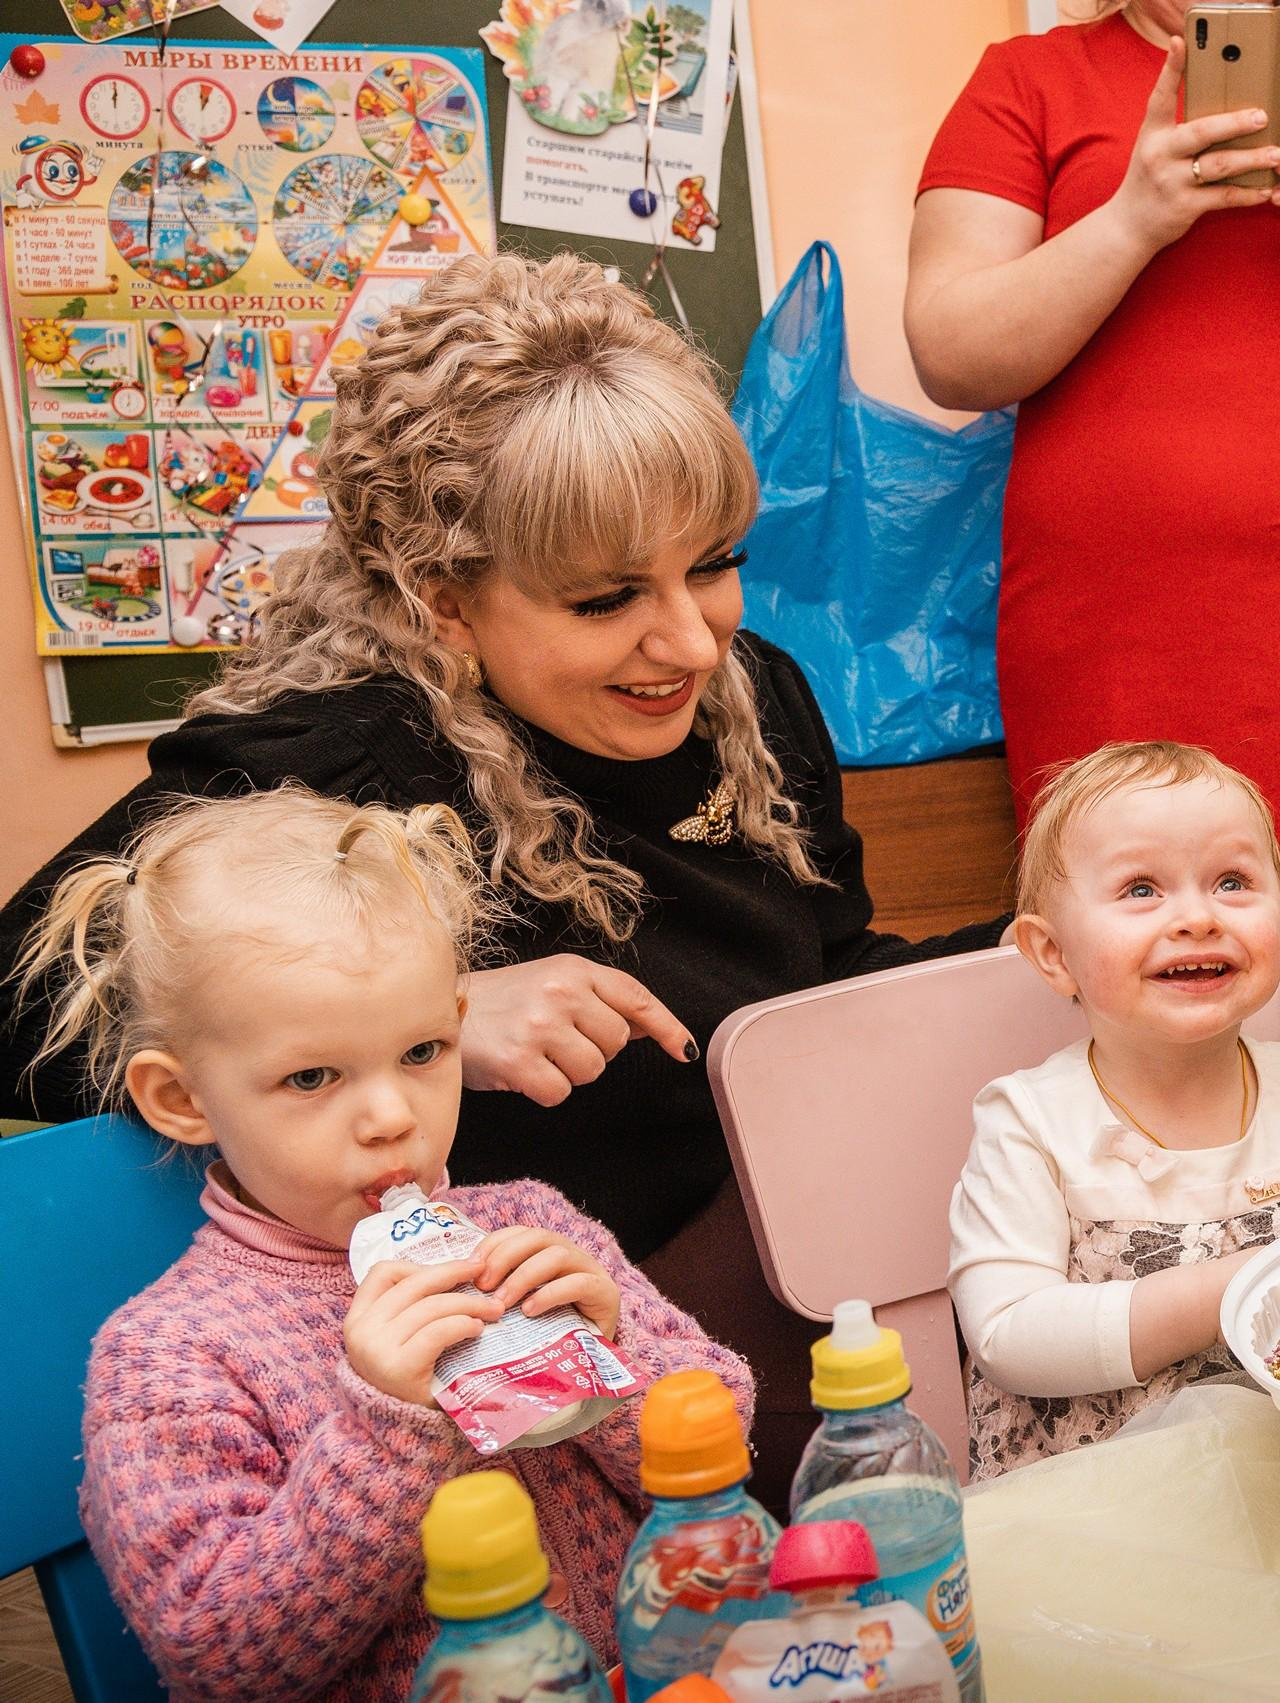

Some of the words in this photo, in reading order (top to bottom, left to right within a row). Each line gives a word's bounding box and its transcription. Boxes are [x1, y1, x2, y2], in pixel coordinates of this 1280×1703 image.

[123, 51, 213, 69] МЕРЫ
[223, 54, 363, 73] ВРЕМЕНИ
[96, 141, 143, 150] минута
[238, 144, 274, 152] сутки
[527, 136, 585, 153] Старшим
[537, 174, 610, 193] транспорте
[523, 189, 584, 206] уступать!
[131, 295, 326, 311] РАСПОРЯДОК
[237, 315, 285, 328] УТРО
[245, 426, 283, 440] ДЕН
